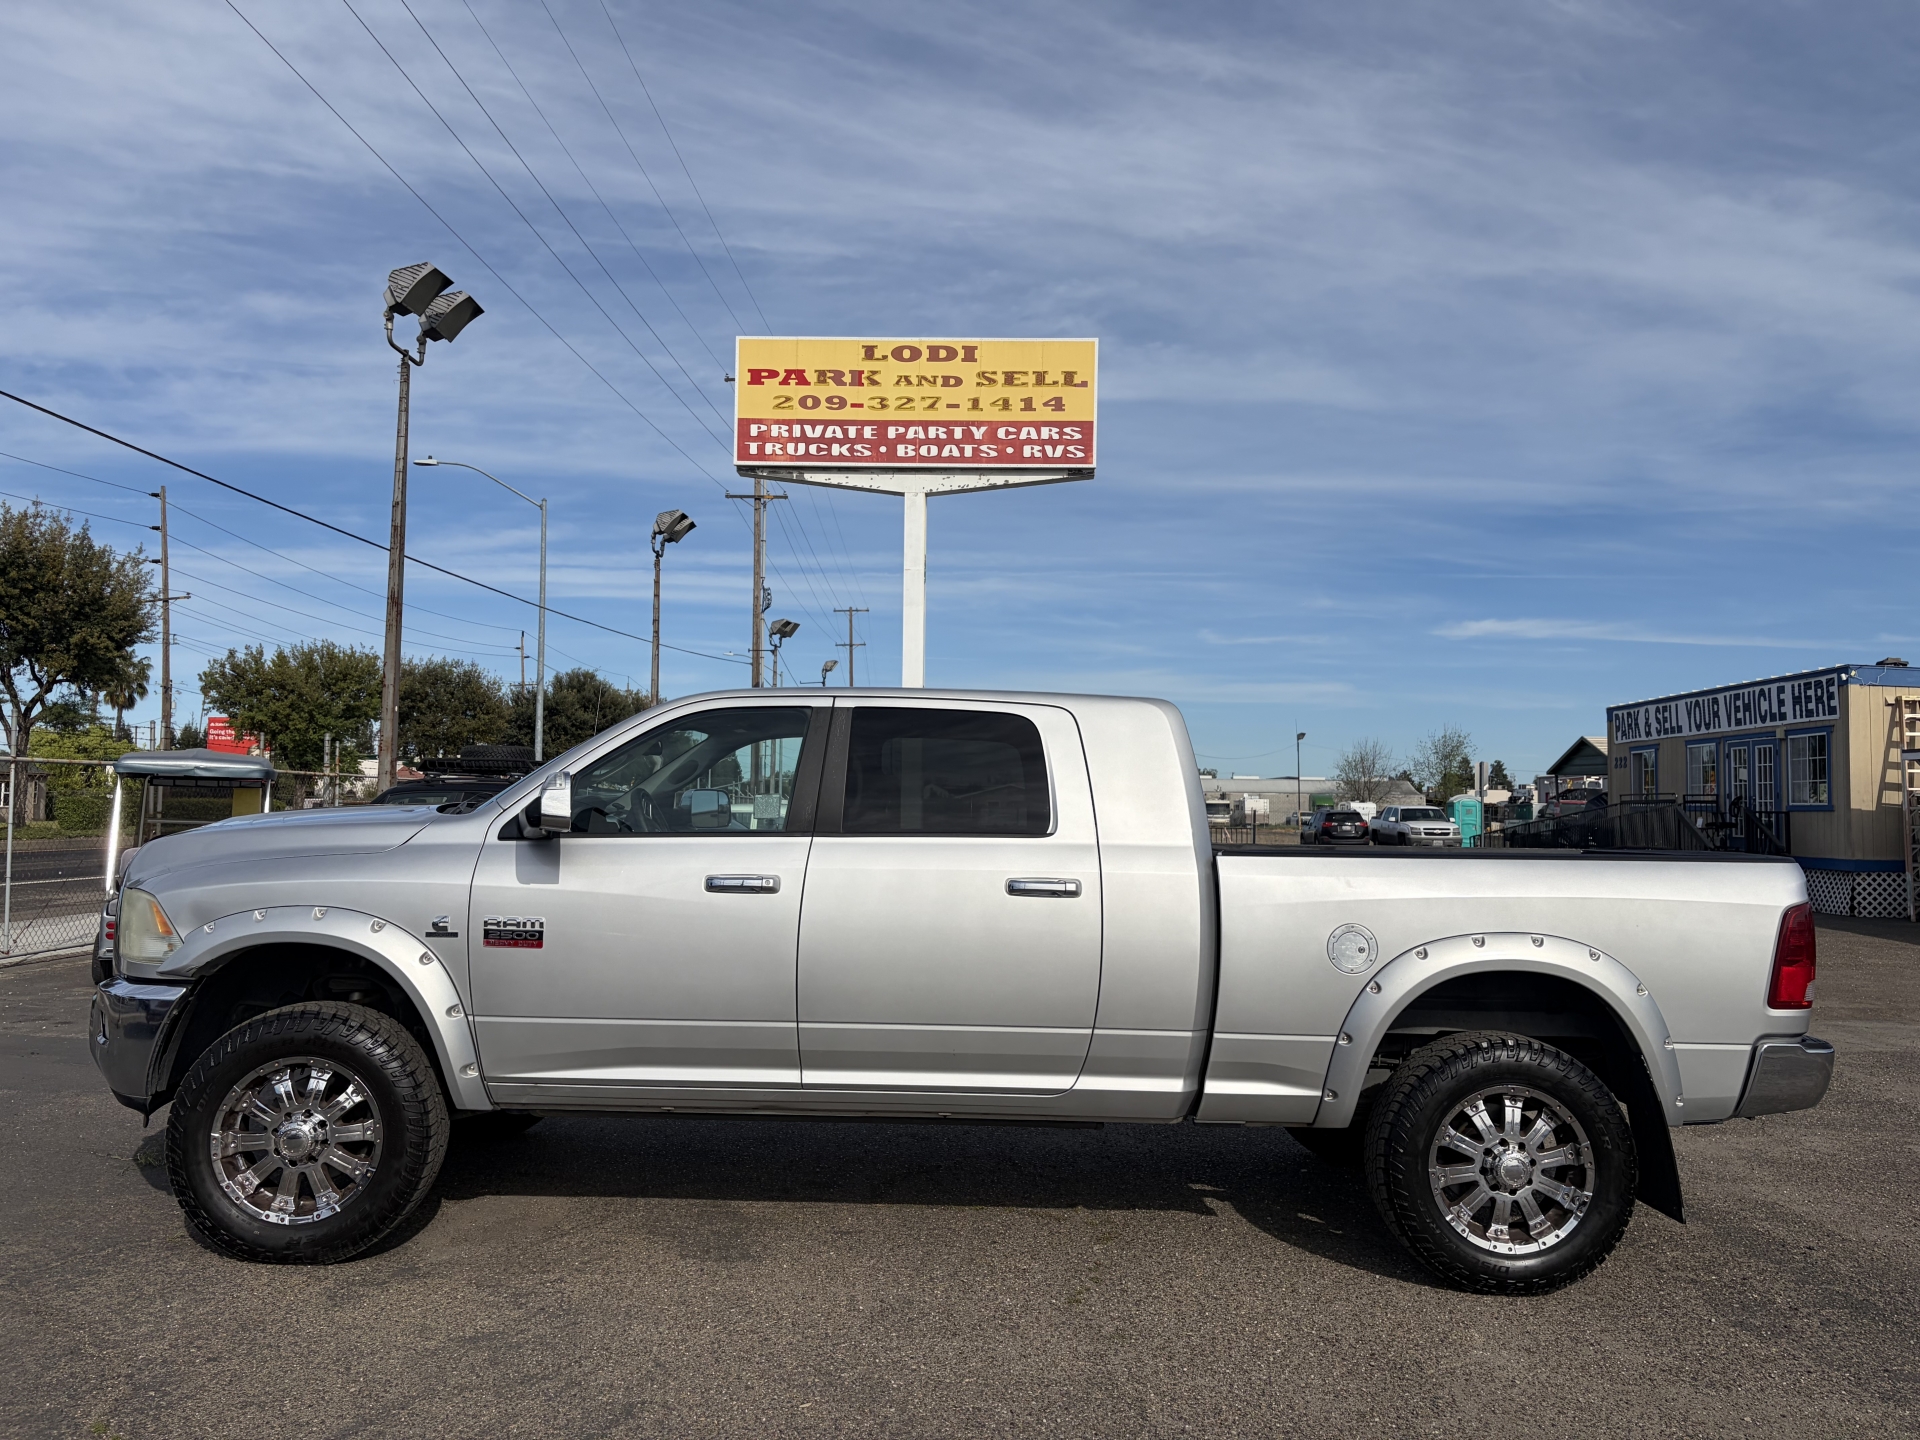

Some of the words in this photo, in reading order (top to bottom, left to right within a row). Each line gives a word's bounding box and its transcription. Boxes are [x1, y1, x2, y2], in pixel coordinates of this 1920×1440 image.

[861, 344, 979, 363] LODI
[746, 368, 883, 388] PARK
[893, 374, 964, 389] AND
[975, 370, 1089, 388] SELL
[772, 394, 1066, 412] 209-327-1414
[749, 423, 878, 439] PRIVATE
[887, 426, 989, 440] PARTY
[996, 426, 1083, 441] CARS
[744, 441, 872, 457] TRUCKS
[896, 444, 999, 459] BOATS
[1022, 444, 1086, 459] RVS
[1614, 709, 1642, 741] PARK
[1644, 707, 1653, 739] &
[1655, 703, 1683, 737] SELL
[1685, 697, 1722, 733] YOUR
[1723, 684, 1788, 728] VEHICLE
[1791, 677, 1838, 720] HERE
[484, 915, 545, 929] RAM
[487, 930, 540, 940] 2500
